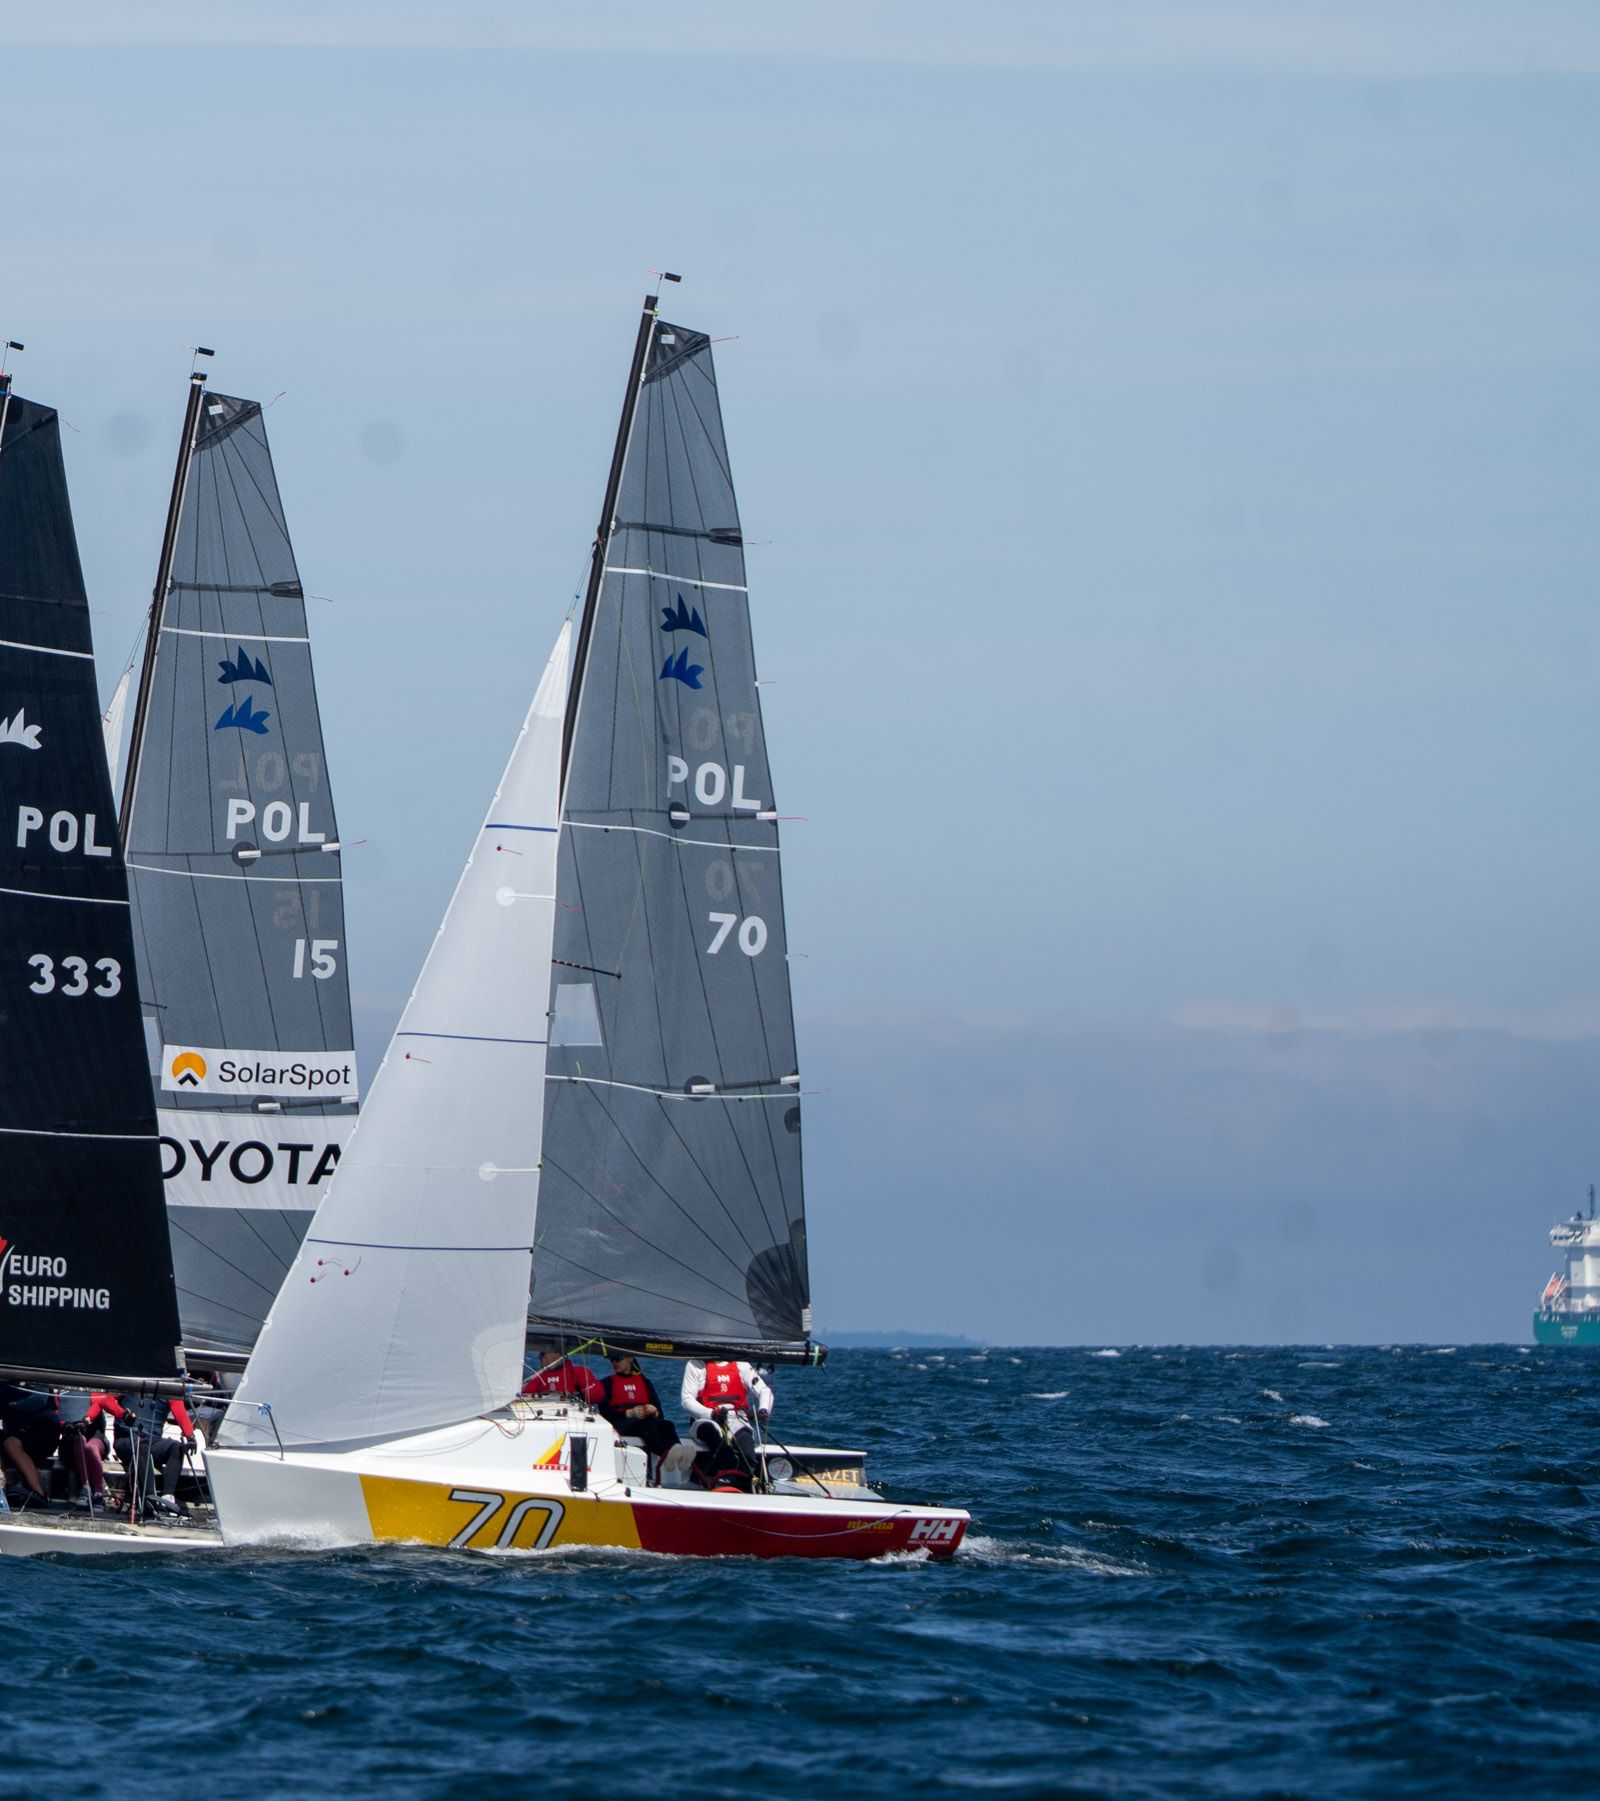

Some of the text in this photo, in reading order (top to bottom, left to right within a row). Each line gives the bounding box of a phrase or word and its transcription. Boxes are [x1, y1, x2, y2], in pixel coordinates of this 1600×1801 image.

[666, 755, 762, 811] POL
[16, 805, 112, 858] POL
[225, 798, 326, 844] POL
[707, 911, 768, 957] 70
[27, 953, 122, 997] 333
[292, 939, 339, 980] 15
[218, 1060, 351, 1090] SolarSpot
[160, 1136, 342, 1186] OYOTA
[9, 1254, 67, 1278] EURO
[8, 1284, 110, 1310] SHIPPING
[447, 1488, 565, 1549] 70
[910, 1519, 959, 1540] HH
